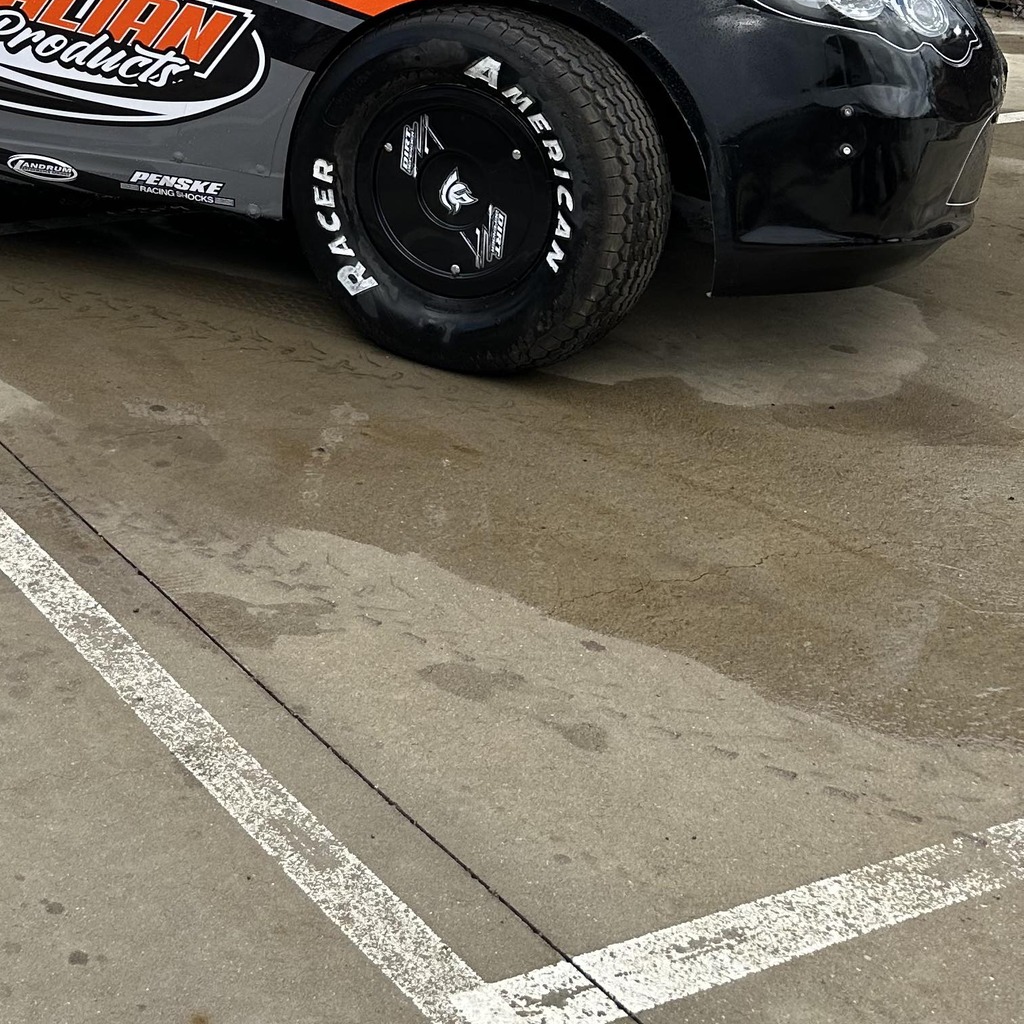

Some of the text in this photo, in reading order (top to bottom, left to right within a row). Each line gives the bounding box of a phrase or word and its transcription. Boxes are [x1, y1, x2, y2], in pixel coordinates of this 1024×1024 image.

[12, 159, 73, 173] LANDRUM
[401, 125, 414, 172] DIRT
[463, 55, 576, 273] AMERICAN
[129, 170, 225, 195] PENSKE
[139, 184, 214, 204] RACING SHOCKS
[312, 157, 379, 297] RACER
[495, 209, 507, 259] DIRT
